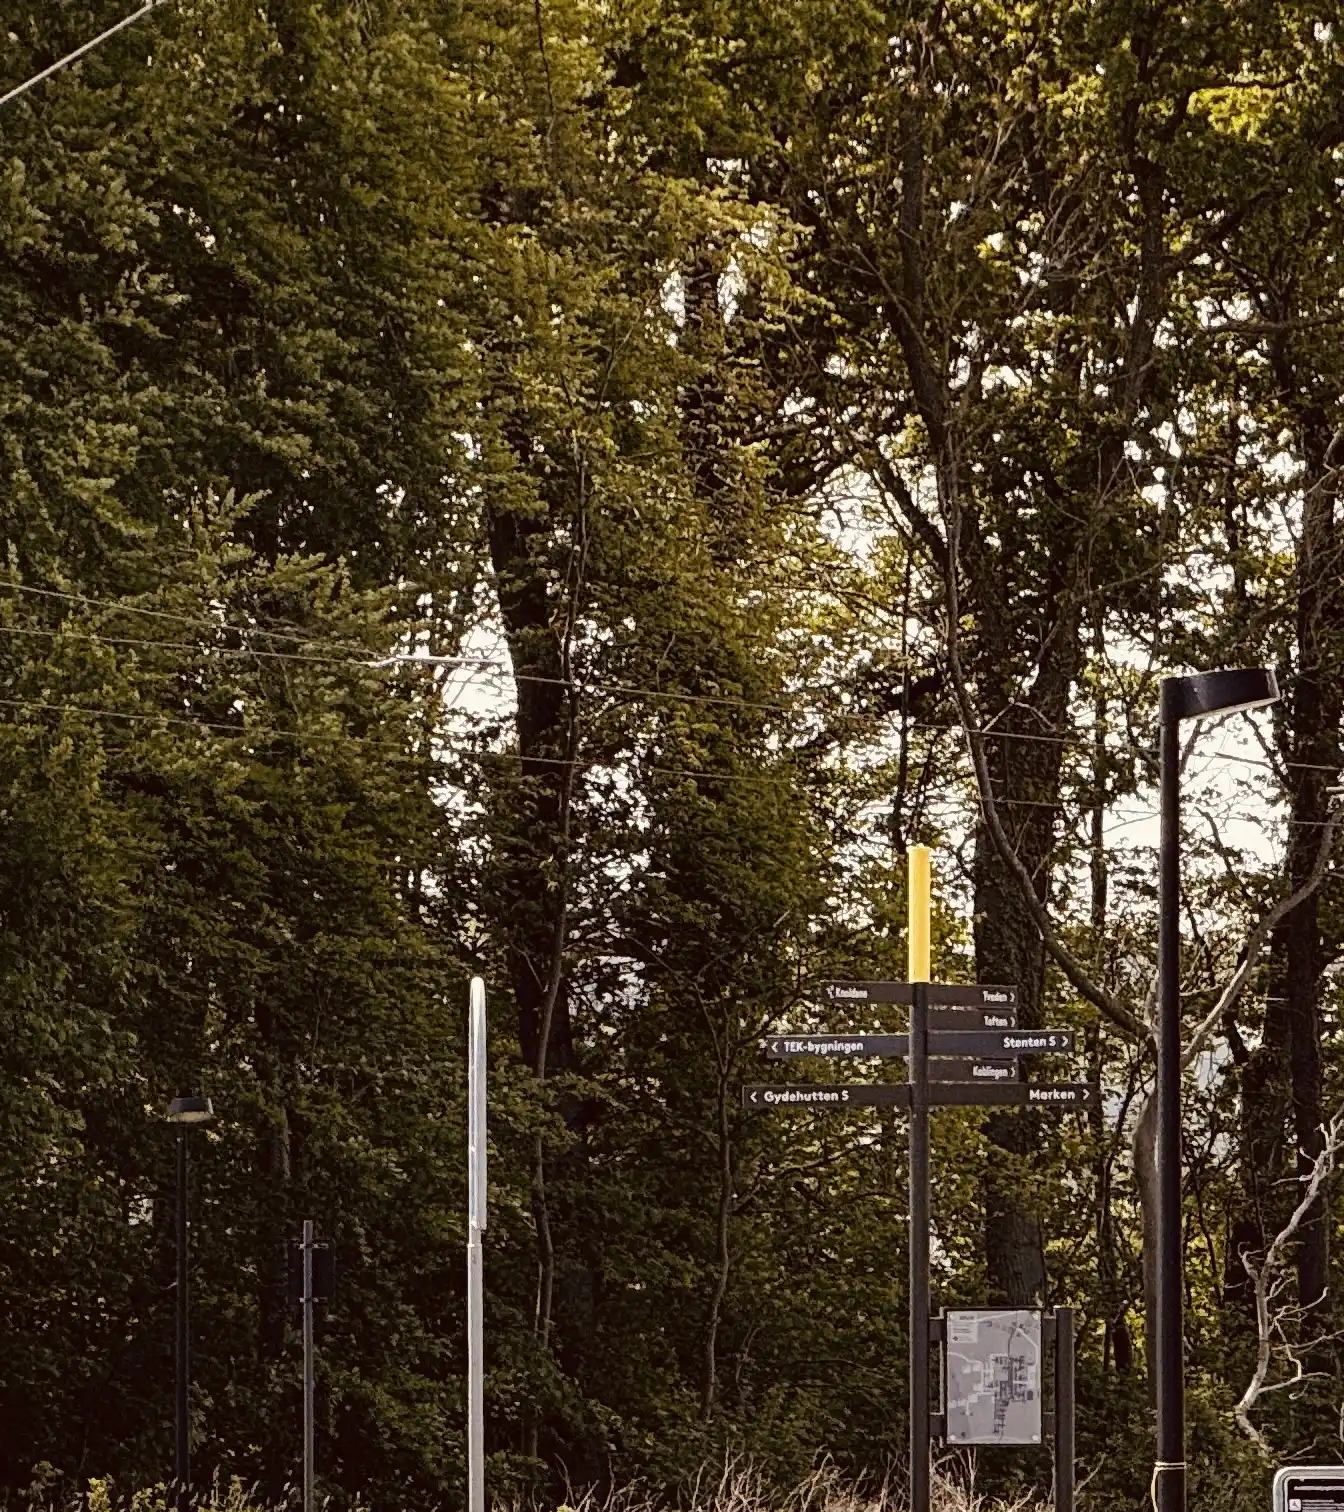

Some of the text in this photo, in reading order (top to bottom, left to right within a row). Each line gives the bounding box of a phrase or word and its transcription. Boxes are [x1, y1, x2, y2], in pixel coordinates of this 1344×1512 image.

[784, 1040, 864, 1054] TEK-bygningen
[1048, 1035, 1057, 1047] S
[764, 1089, 850, 1104] Gydehutten S
[1029, 1088, 1076, 1100] Marken
